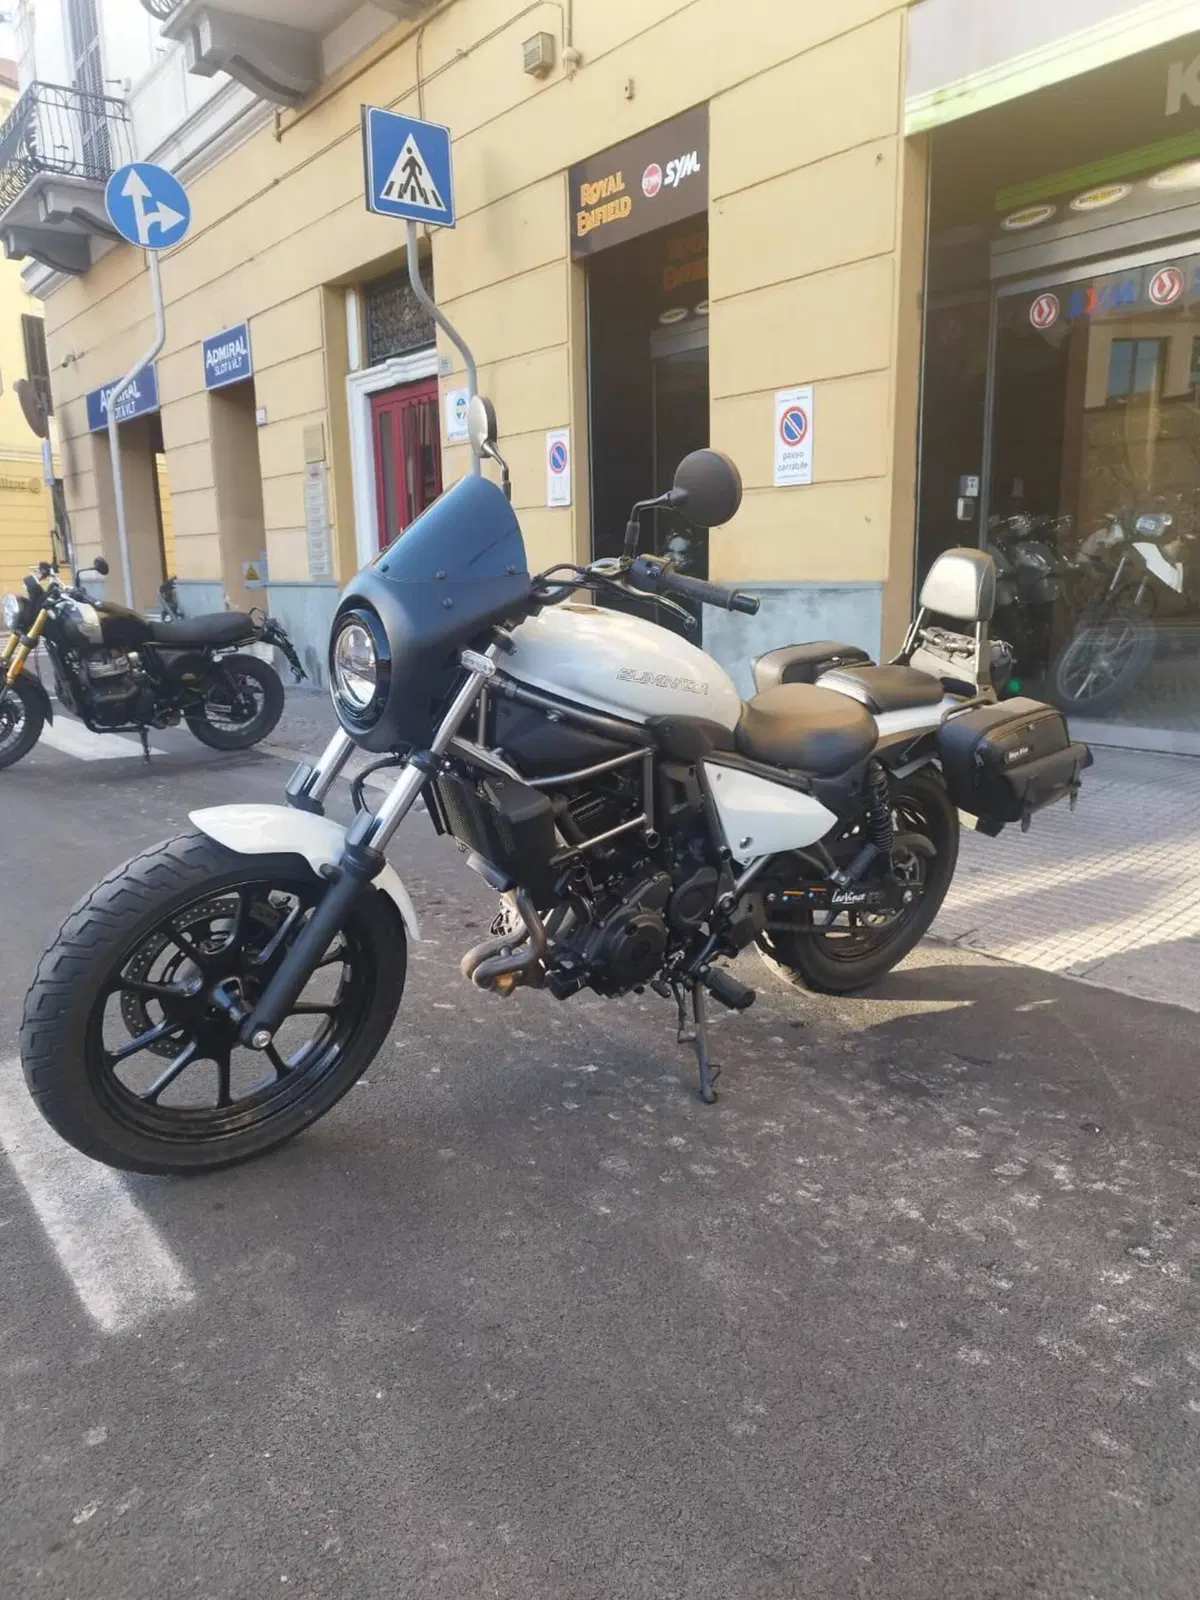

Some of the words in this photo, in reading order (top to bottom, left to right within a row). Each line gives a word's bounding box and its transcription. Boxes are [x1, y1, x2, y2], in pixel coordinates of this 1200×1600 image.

[664, 150, 700, 188] SYM
[580, 171, 625, 207] ROYAL
[576, 195, 632, 237] ENFIELD
[205, 335, 248, 369] ADMIRAL
[100, 380, 142, 413] ADRAL
